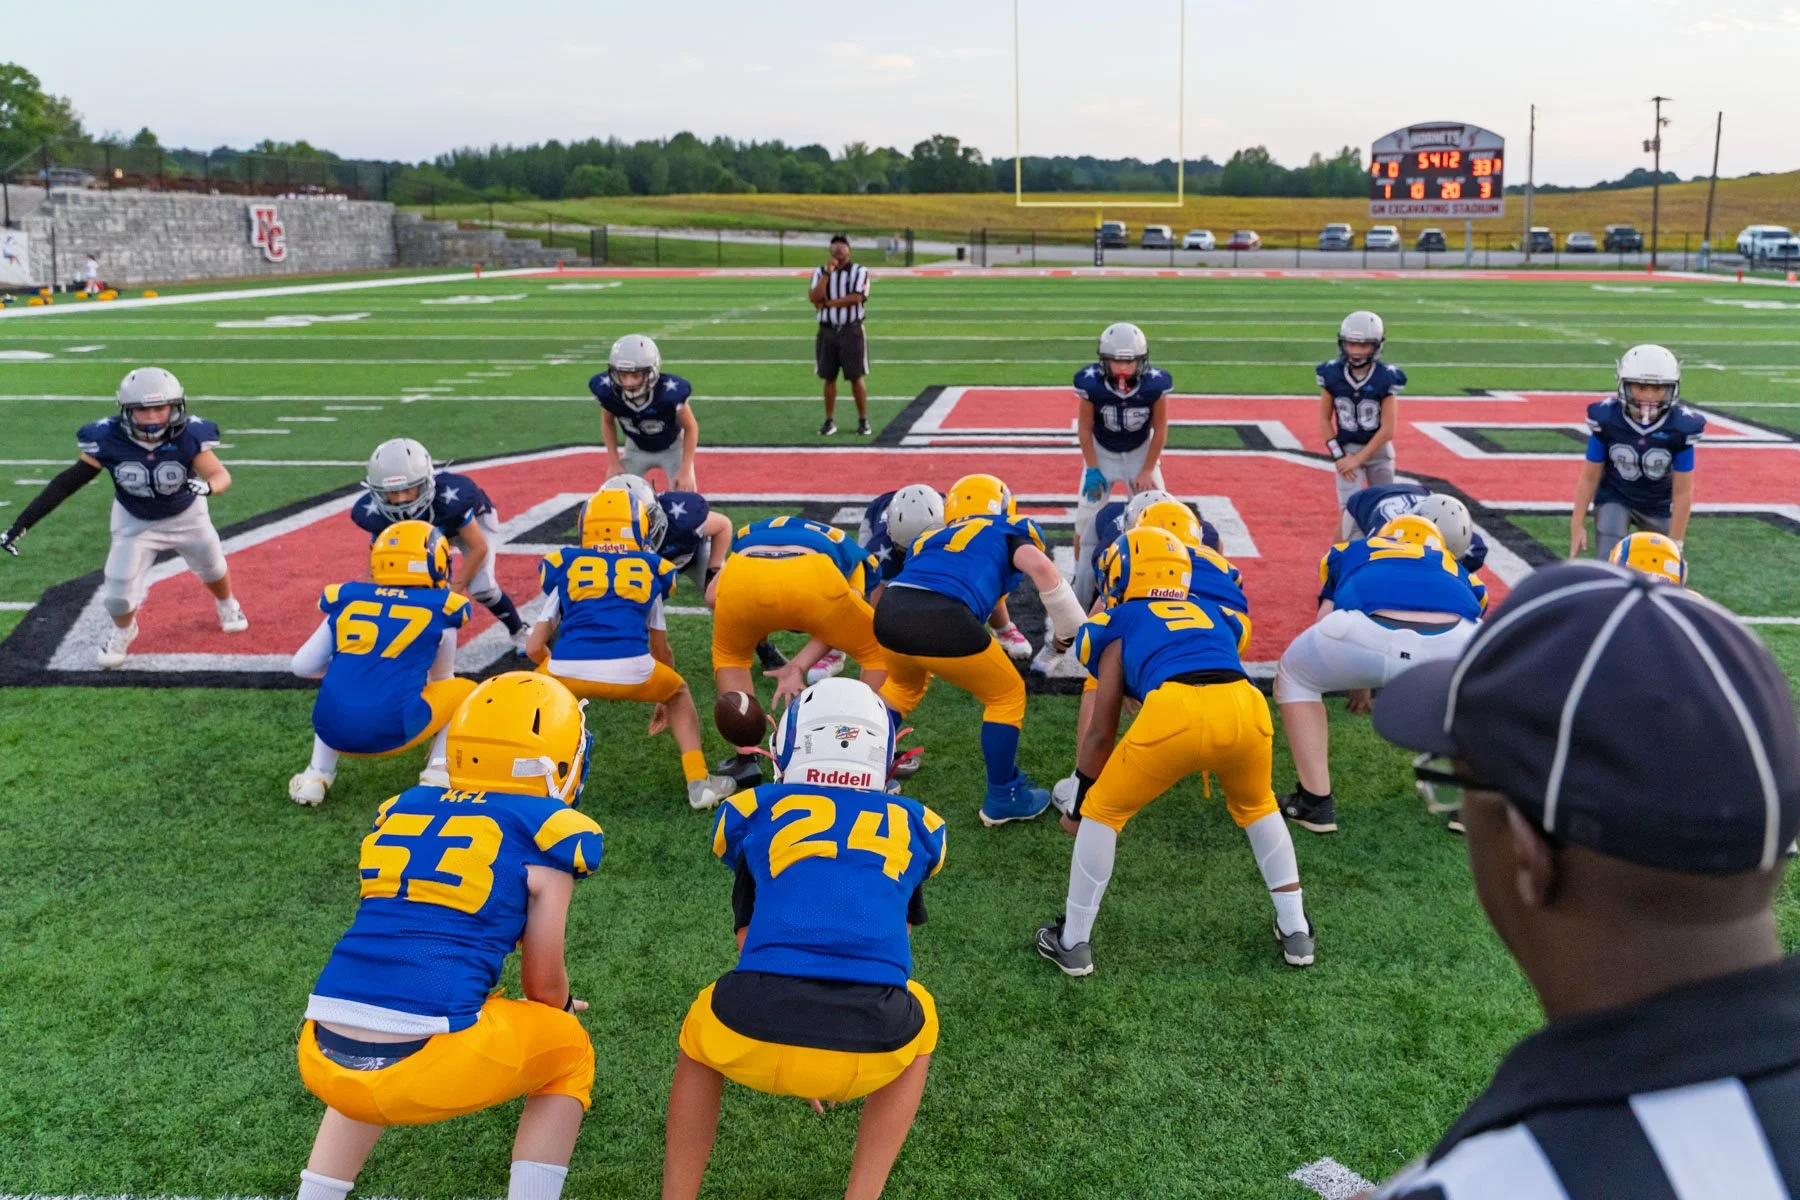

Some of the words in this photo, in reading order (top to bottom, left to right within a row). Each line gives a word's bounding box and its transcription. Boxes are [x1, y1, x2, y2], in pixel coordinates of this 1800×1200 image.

[374, 587, 408, 599] KFL
[567, 556, 654, 604] 88
[1150, 588, 1185, 599] Riddell
[336, 600, 433, 659] 67
[1148, 601, 1214, 631] 9
[806, 768, 871, 787] Riddell
[439, 789, 488, 804] KFL
[769, 794, 913, 882] 24
[359, 812, 503, 914] 53
